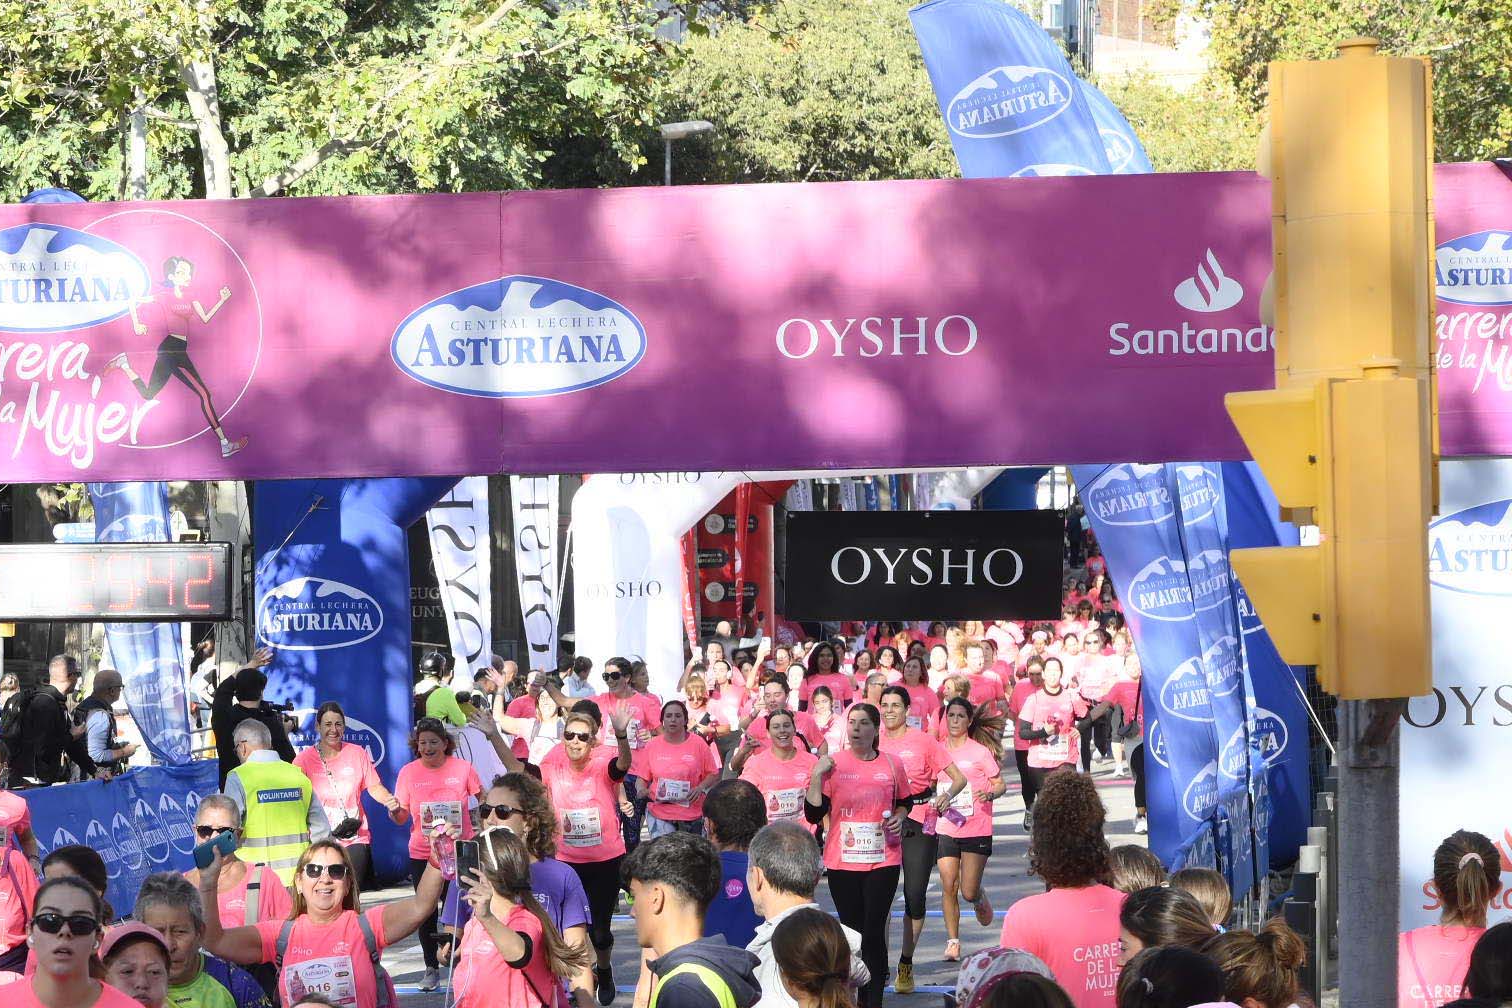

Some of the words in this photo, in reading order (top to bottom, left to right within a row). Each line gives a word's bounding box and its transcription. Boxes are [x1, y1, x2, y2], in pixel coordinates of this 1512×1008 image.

[450, 319, 530, 331] CENTRAL
[537, 316, 619, 329] LECHERA
[411, 323, 626, 367] ASTURIANA
[776, 315, 979, 358] OYSHO
[1109, 322, 1276, 355] Santand
[1459, 343, 1477, 369] la
[12, 375, 161, 470] Mujer
[830, 547, 1025, 588] OYSHO
[586, 580, 662, 599] OYSHO
[274, 602, 317, 611] CENTRAL
[320, 601, 370, 611] LECHERA
[262, 608, 374, 634] ASTURIANA
[258, 788, 299, 801] VOLUNTARIS
[840, 808, 853, 817] TU
[1074, 942, 1122, 963] CARRE
[1088, 961, 1105, 976] DE
[1109, 961, 1120, 975] L
[308, 982, 331, 993] 016
